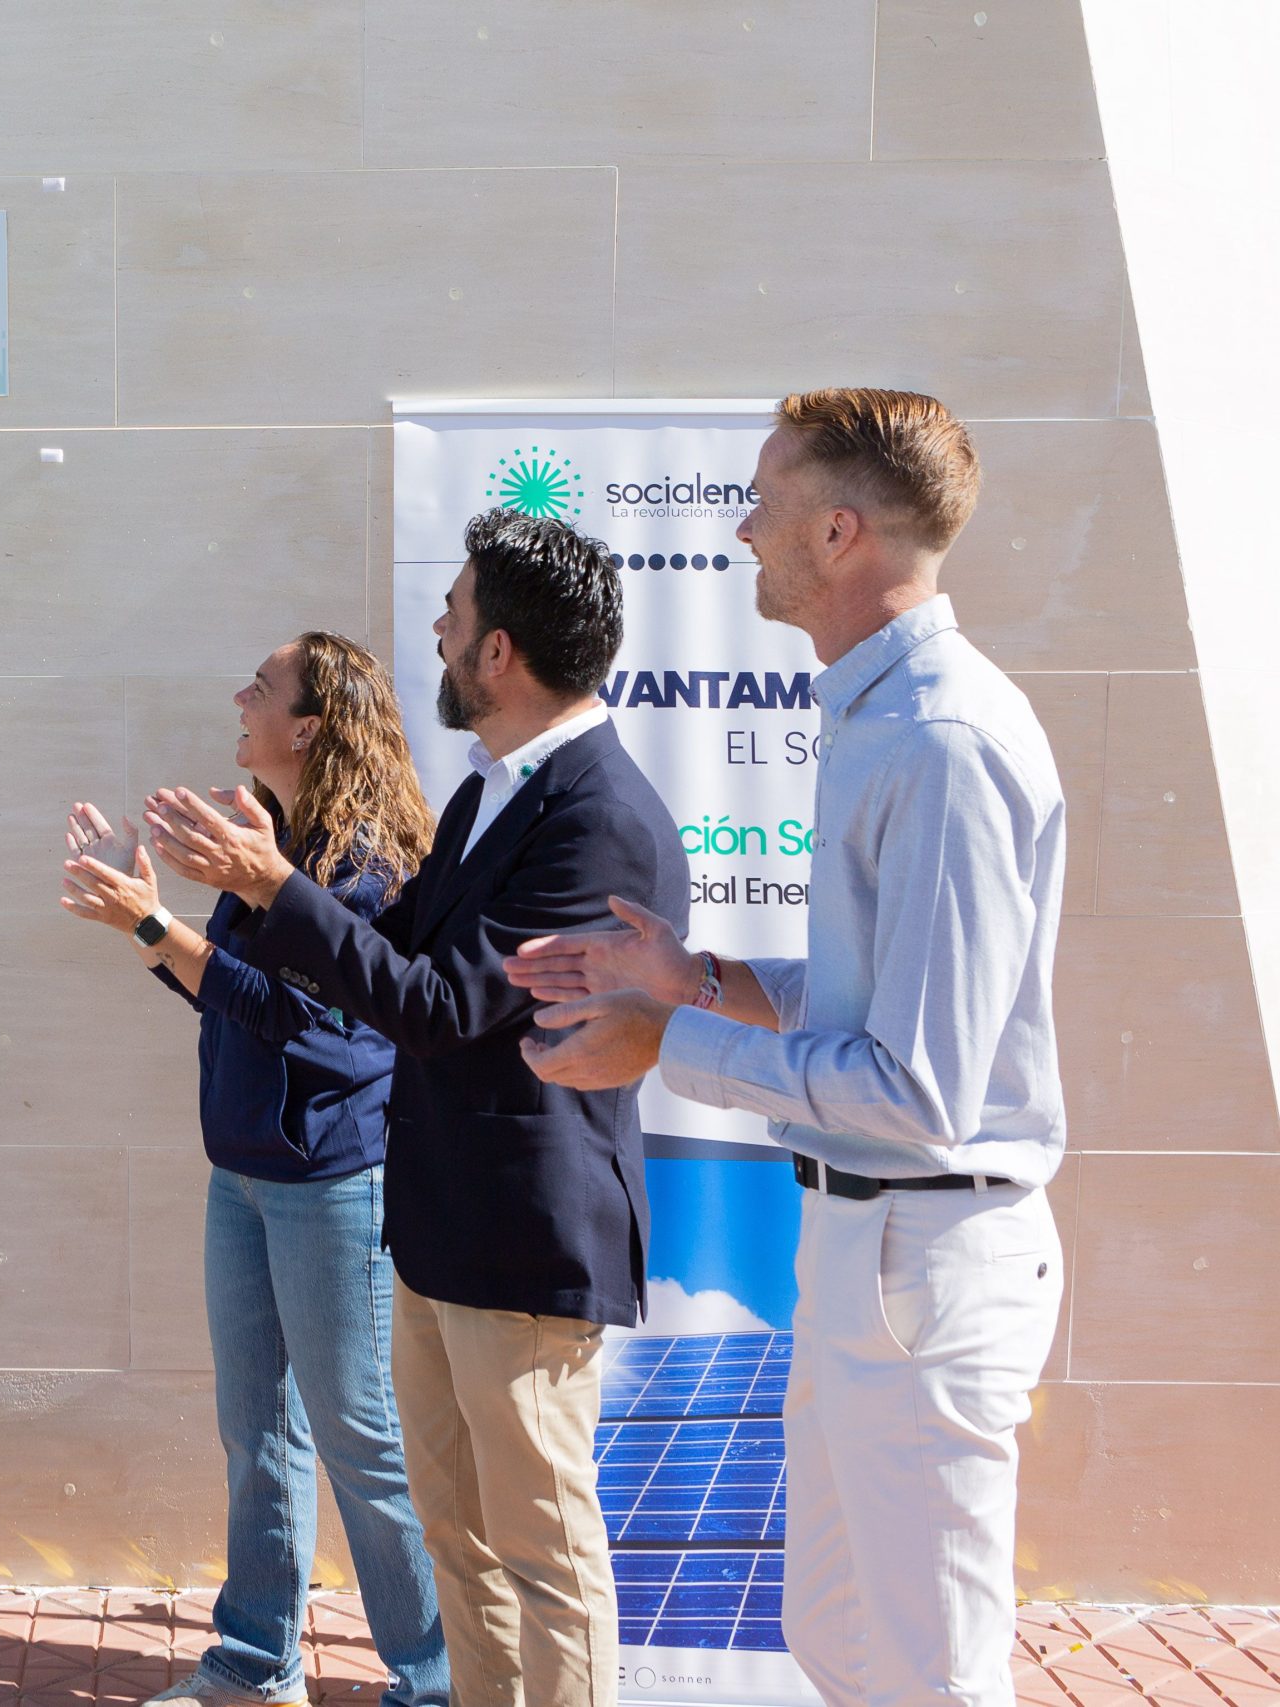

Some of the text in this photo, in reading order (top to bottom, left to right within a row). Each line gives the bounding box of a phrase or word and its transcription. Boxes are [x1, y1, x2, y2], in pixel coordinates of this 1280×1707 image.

[611, 505, 753, 518] La revolución sola
[596, 670, 821, 710] VANTAM
[727, 730, 768, 765] EL
[661, 1674, 712, 1684] sonnen
